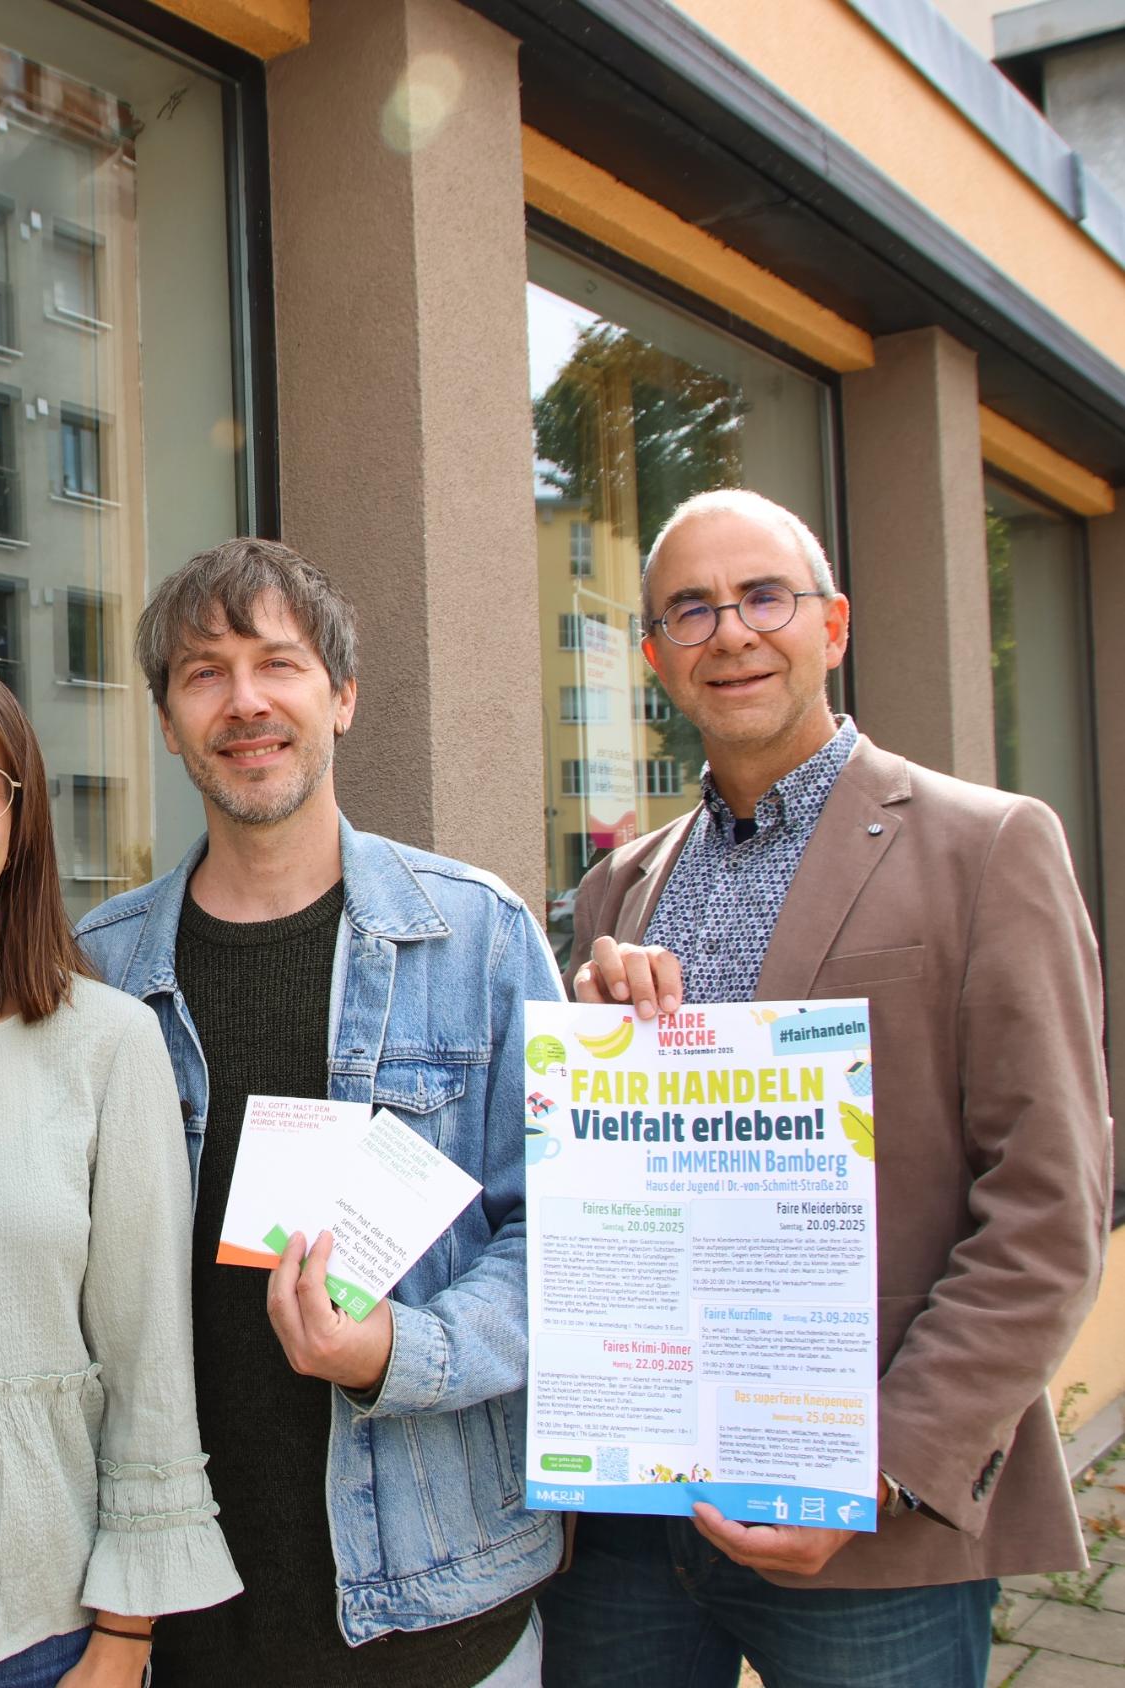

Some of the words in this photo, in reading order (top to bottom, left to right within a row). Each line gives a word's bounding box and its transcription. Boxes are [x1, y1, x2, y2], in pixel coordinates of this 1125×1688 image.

[657, 1013, 704, 1029] FAIRE
[658, 1031, 715, 1046] WOCHE
[780, 1021, 865, 1042] #fairhandeln
[684, 1047, 717, 1056] September
[718, 1046, 734, 1055] 2025
[572, 1070, 648, 1104] FAIR
[660, 1067, 823, 1104] HANDELN
[251, 1109, 291, 1119] MENSCHEN
[293, 1112, 320, 1121] MACHT
[321, 1114, 338, 1123] UND
[293, 1103, 313, 1112] HAST
[315, 1105, 331, 1113] DEM
[571, 1108, 684, 1142] Vielfalt
[693, 1109, 823, 1141] erleben!
[647, 1150, 668, 1172] im
[673, 1150, 760, 1172] IMMERHIN
[765, 1150, 847, 1177] Bamberg
[646, 1179, 670, 1192] Haus
[670, 1179, 685, 1192] der
[687, 1180, 719, 1194] Jugend
[728, 1178, 834, 1192] Dr.-von-Schmitt-Straße
[836, 1179, 849, 1191] 20
[583, 1201, 610, 1215] Faires
[612, 1203, 682, 1217] Kaffee-Seminar
[777, 1201, 800, 1215] Faire
[802, 1201, 863, 1215] Kleiderbörse
[336, 1199, 357, 1216] Jeder
[357, 1214, 371, 1229] hat
[371, 1226, 385, 1240] das
[385, 1237, 406, 1260] Recht,
[628, 1220, 685, 1234] 20.09.2025
[807, 1219, 866, 1232] 20.09.2025
[332, 1224, 350, 1245] Wort,
[352, 1242, 378, 1266] Schrift
[378, 1264, 395, 1279] und
[341, 1219, 361, 1236] seine
[361, 1235, 392, 1263] Meinung
[392, 1259, 402, 1270] in
[333, 1242, 349, 1257] frei
[348, 1255, 359, 1266] zu
[358, 1264, 384, 1287] äußern
[705, 1306, 727, 1320] Faire
[728, 1307, 773, 1321] Kurzfilme
[810, 1311, 869, 1325] 23.09.2025
[603, 1339, 630, 1353] Faires
[632, 1341, 691, 1356] Krimi-Dinner
[636, 1358, 694, 1373] 22.09.2025
[736, 1391, 751, 1403] Das
[754, 1392, 802, 1406] superfaire
[804, 1394, 862, 1409] Kneipenquiz
[806, 1411, 865, 1426] 25.09.2025
